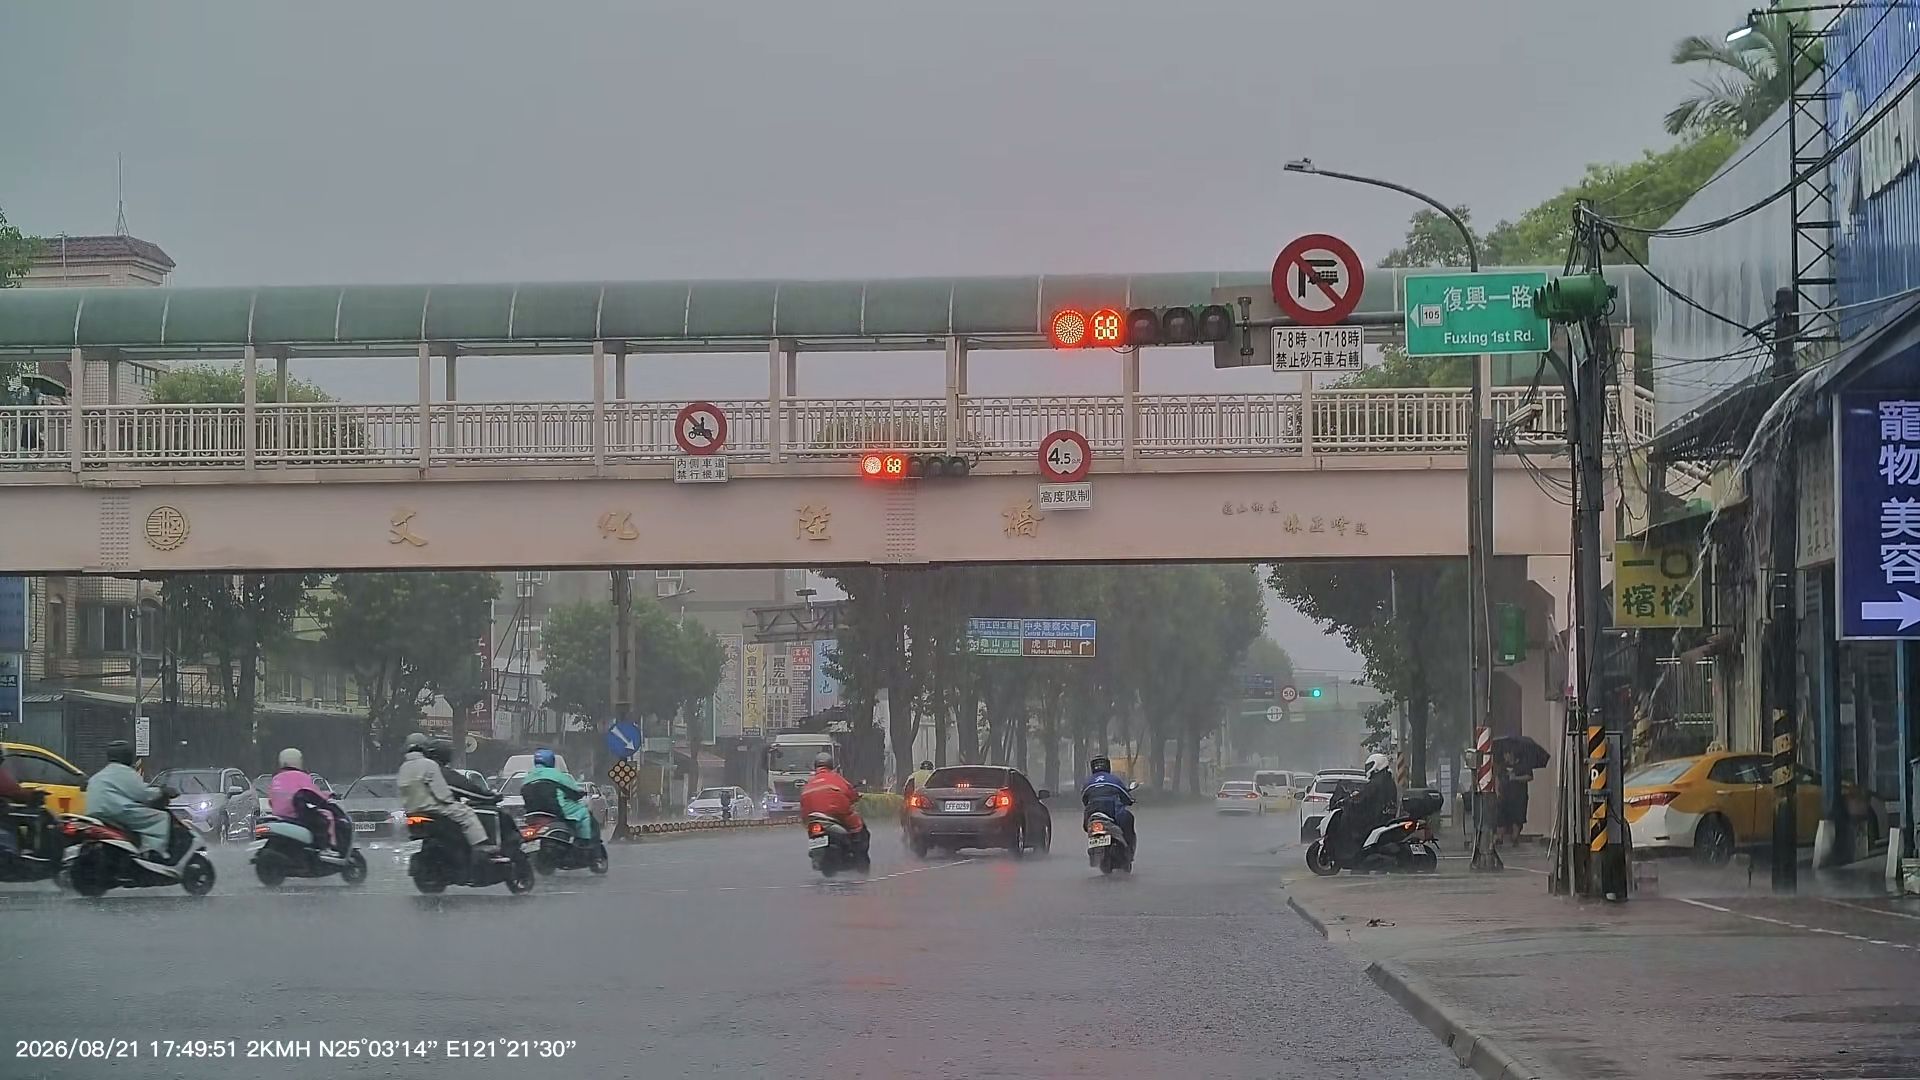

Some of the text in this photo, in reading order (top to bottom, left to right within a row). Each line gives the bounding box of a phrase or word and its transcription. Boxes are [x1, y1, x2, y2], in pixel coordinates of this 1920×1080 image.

[1443, 285, 1533, 312] 復興一路
[1424, 311, 1440, 320] 105
[1095, 315, 1118, 340] 68
[1444, 330, 1535, 346] Fuxing 1st Rd.
[1276, 350, 1360, 369] 禁止砂石車右轉
[1048, 447, 1071, 465] 4.5
[677, 469, 725, 480] 禁行機車
[1041, 489, 1090, 504] 高度限制
[1024, 621, 1080, 631] 中央警察大學
[1283, 689, 1294, 698] 50
